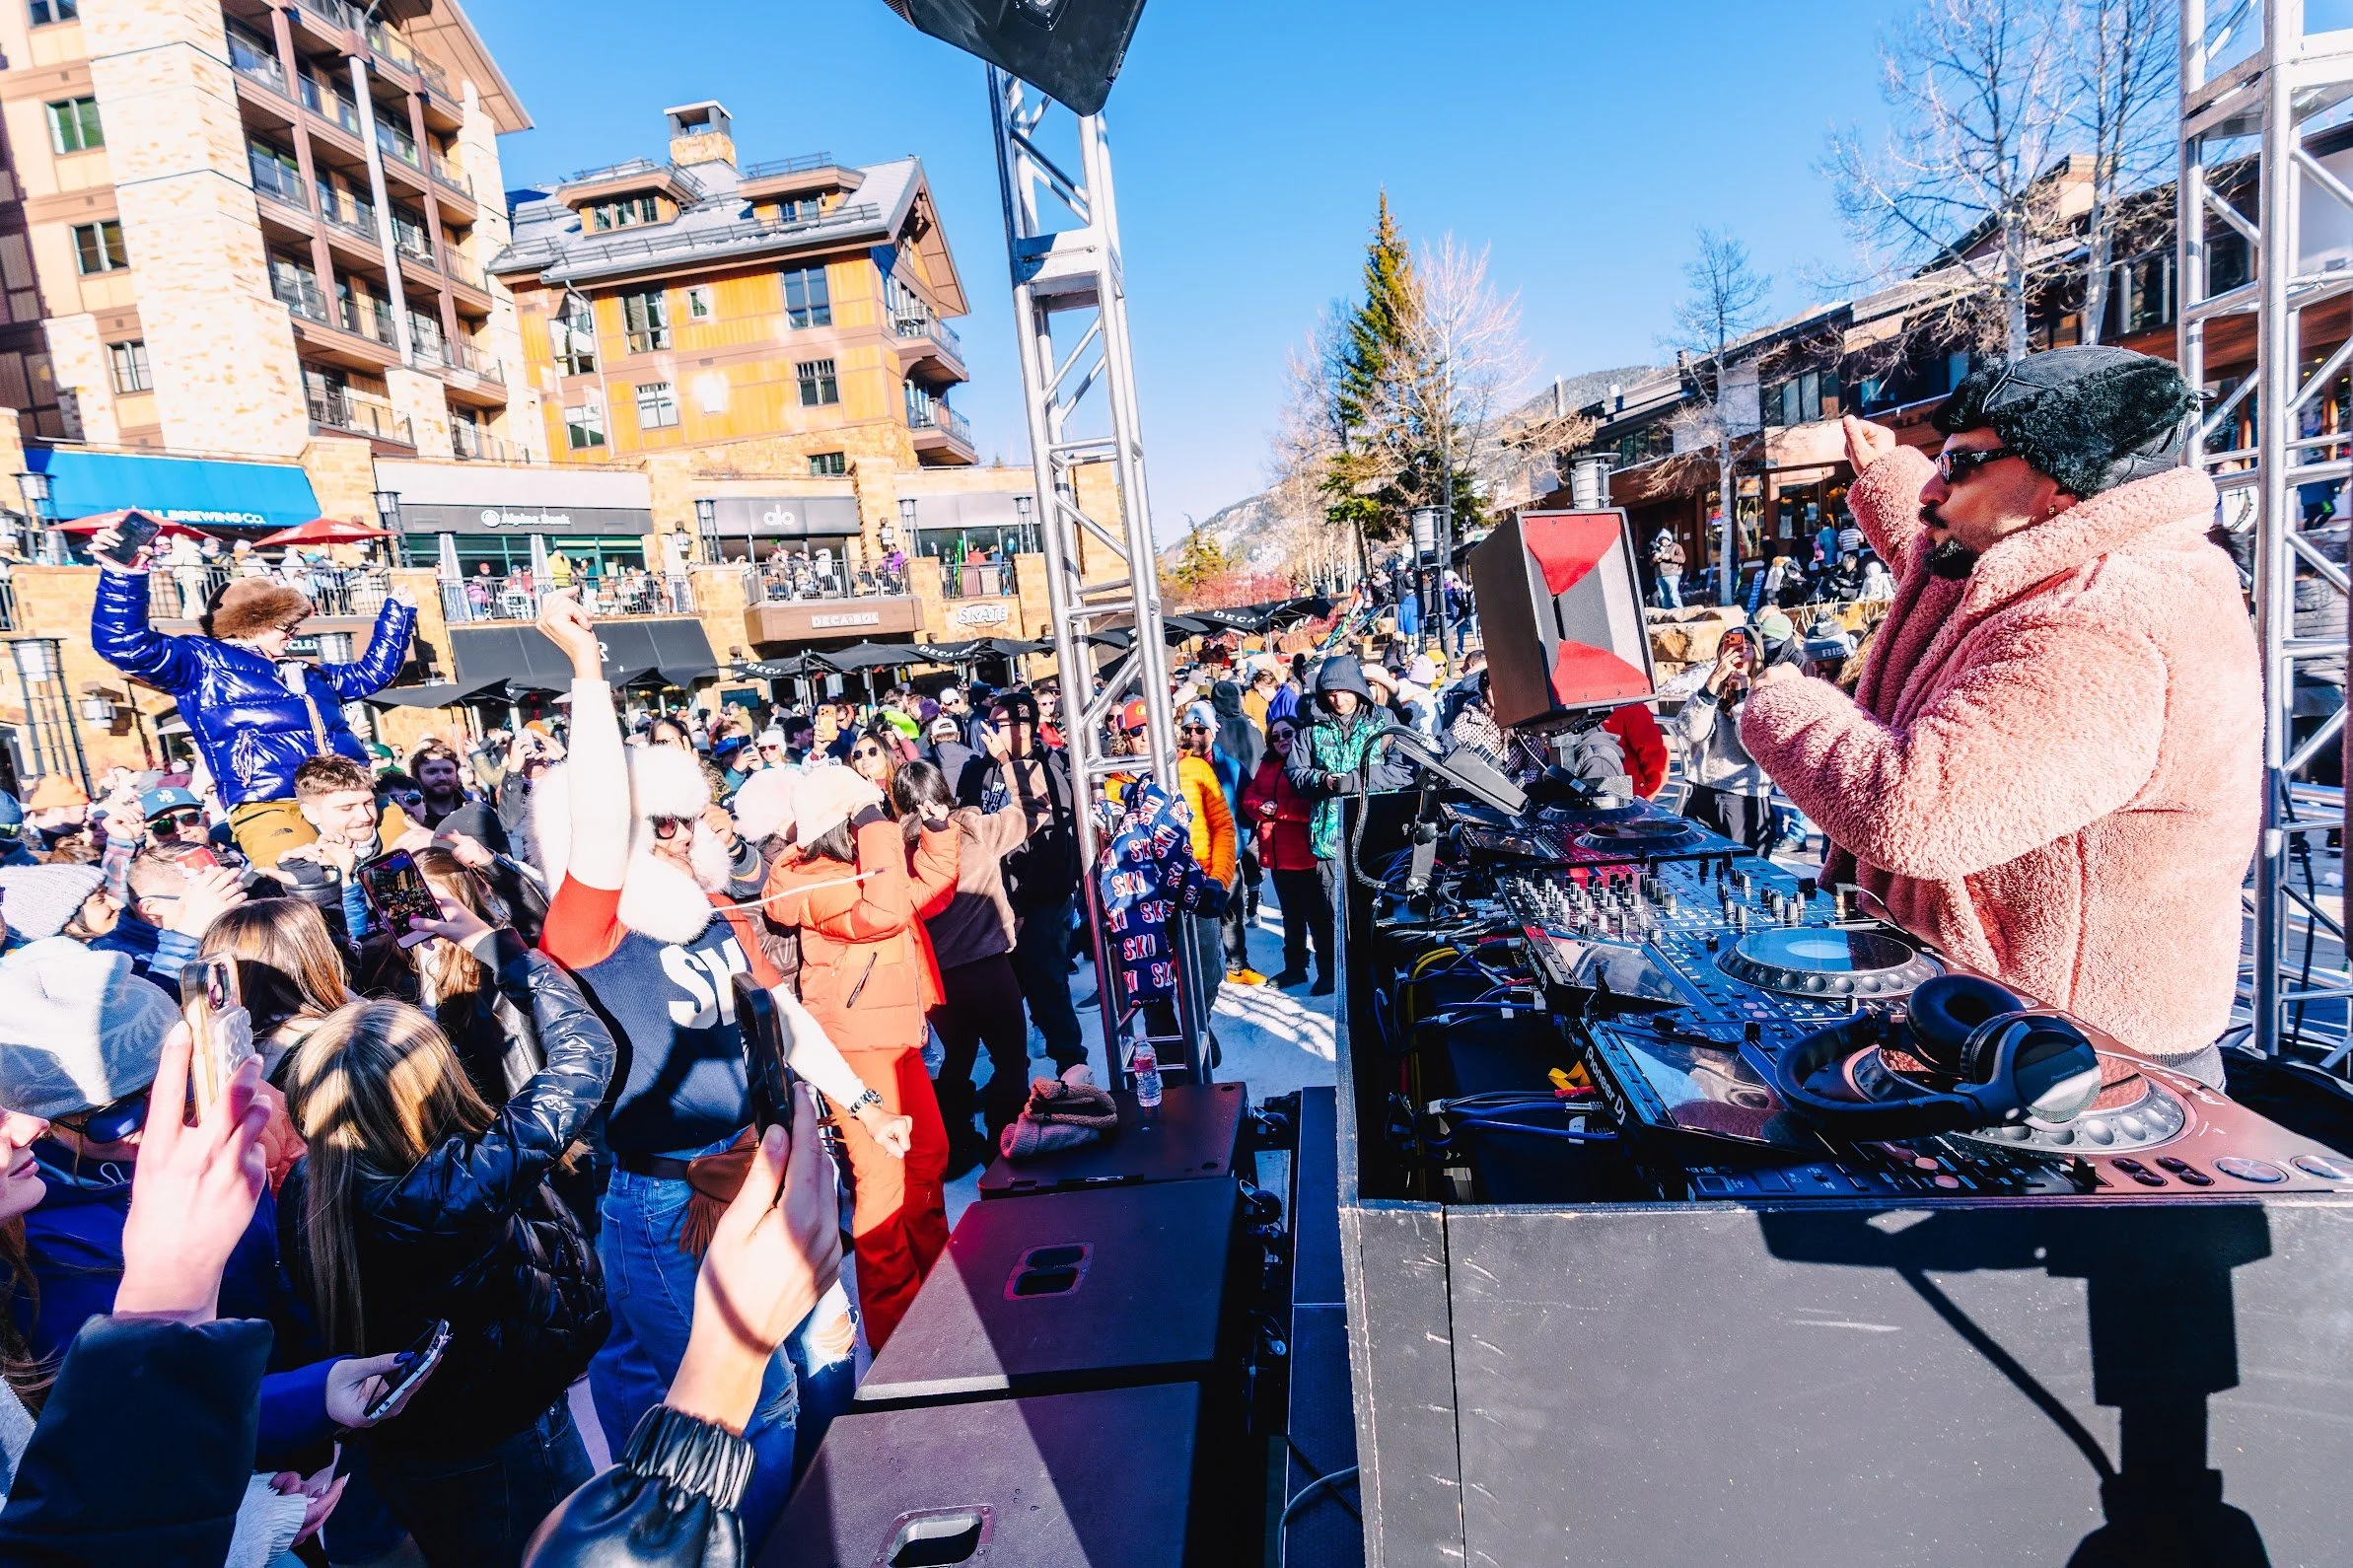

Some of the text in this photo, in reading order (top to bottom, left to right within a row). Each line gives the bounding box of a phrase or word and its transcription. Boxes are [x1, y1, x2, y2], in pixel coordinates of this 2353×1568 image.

[763, 504, 796, 526] alo
[959, 606, 1008, 623] SKATE
[1128, 837, 1154, 863] SK
[1111, 869, 1147, 897] SKI
[1140, 899, 1167, 924] SK
[1123, 933, 1157, 962] SKI
[1585, 1045, 1627, 1126] Pioneer DJ
